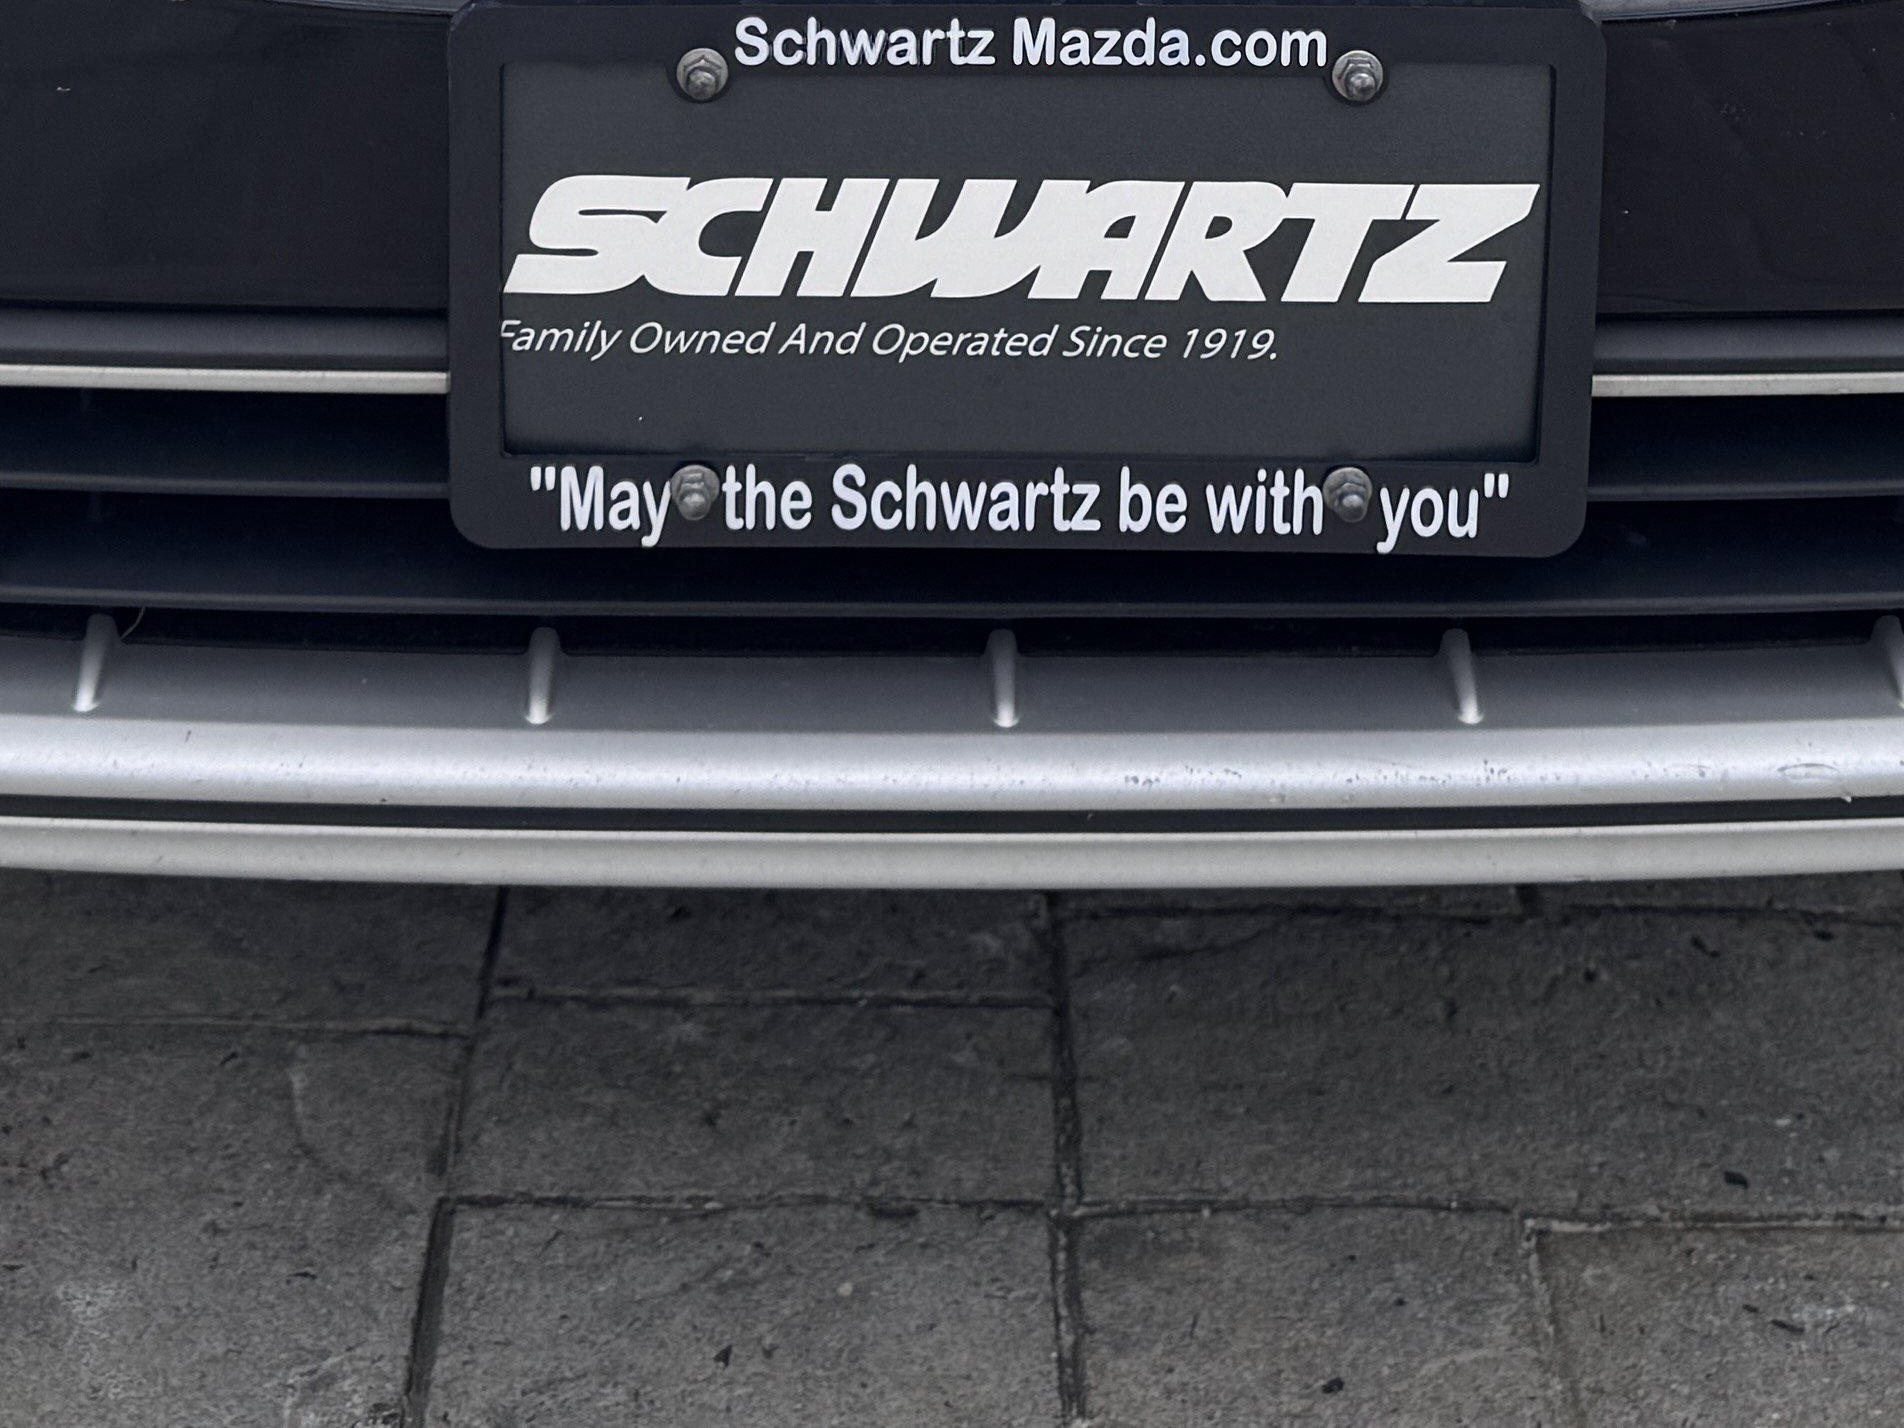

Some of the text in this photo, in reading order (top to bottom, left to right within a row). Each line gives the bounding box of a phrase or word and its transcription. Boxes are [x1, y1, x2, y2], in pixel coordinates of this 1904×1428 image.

[734, 16, 1328, 67] Schwartz Mazda.com
[502, 174, 1541, 304] SCHWARTZ
[499, 319, 1279, 364] Family Owned And Operated Since 1919.
[530, 463, 1511, 555] "May the Schwartz be with you"
